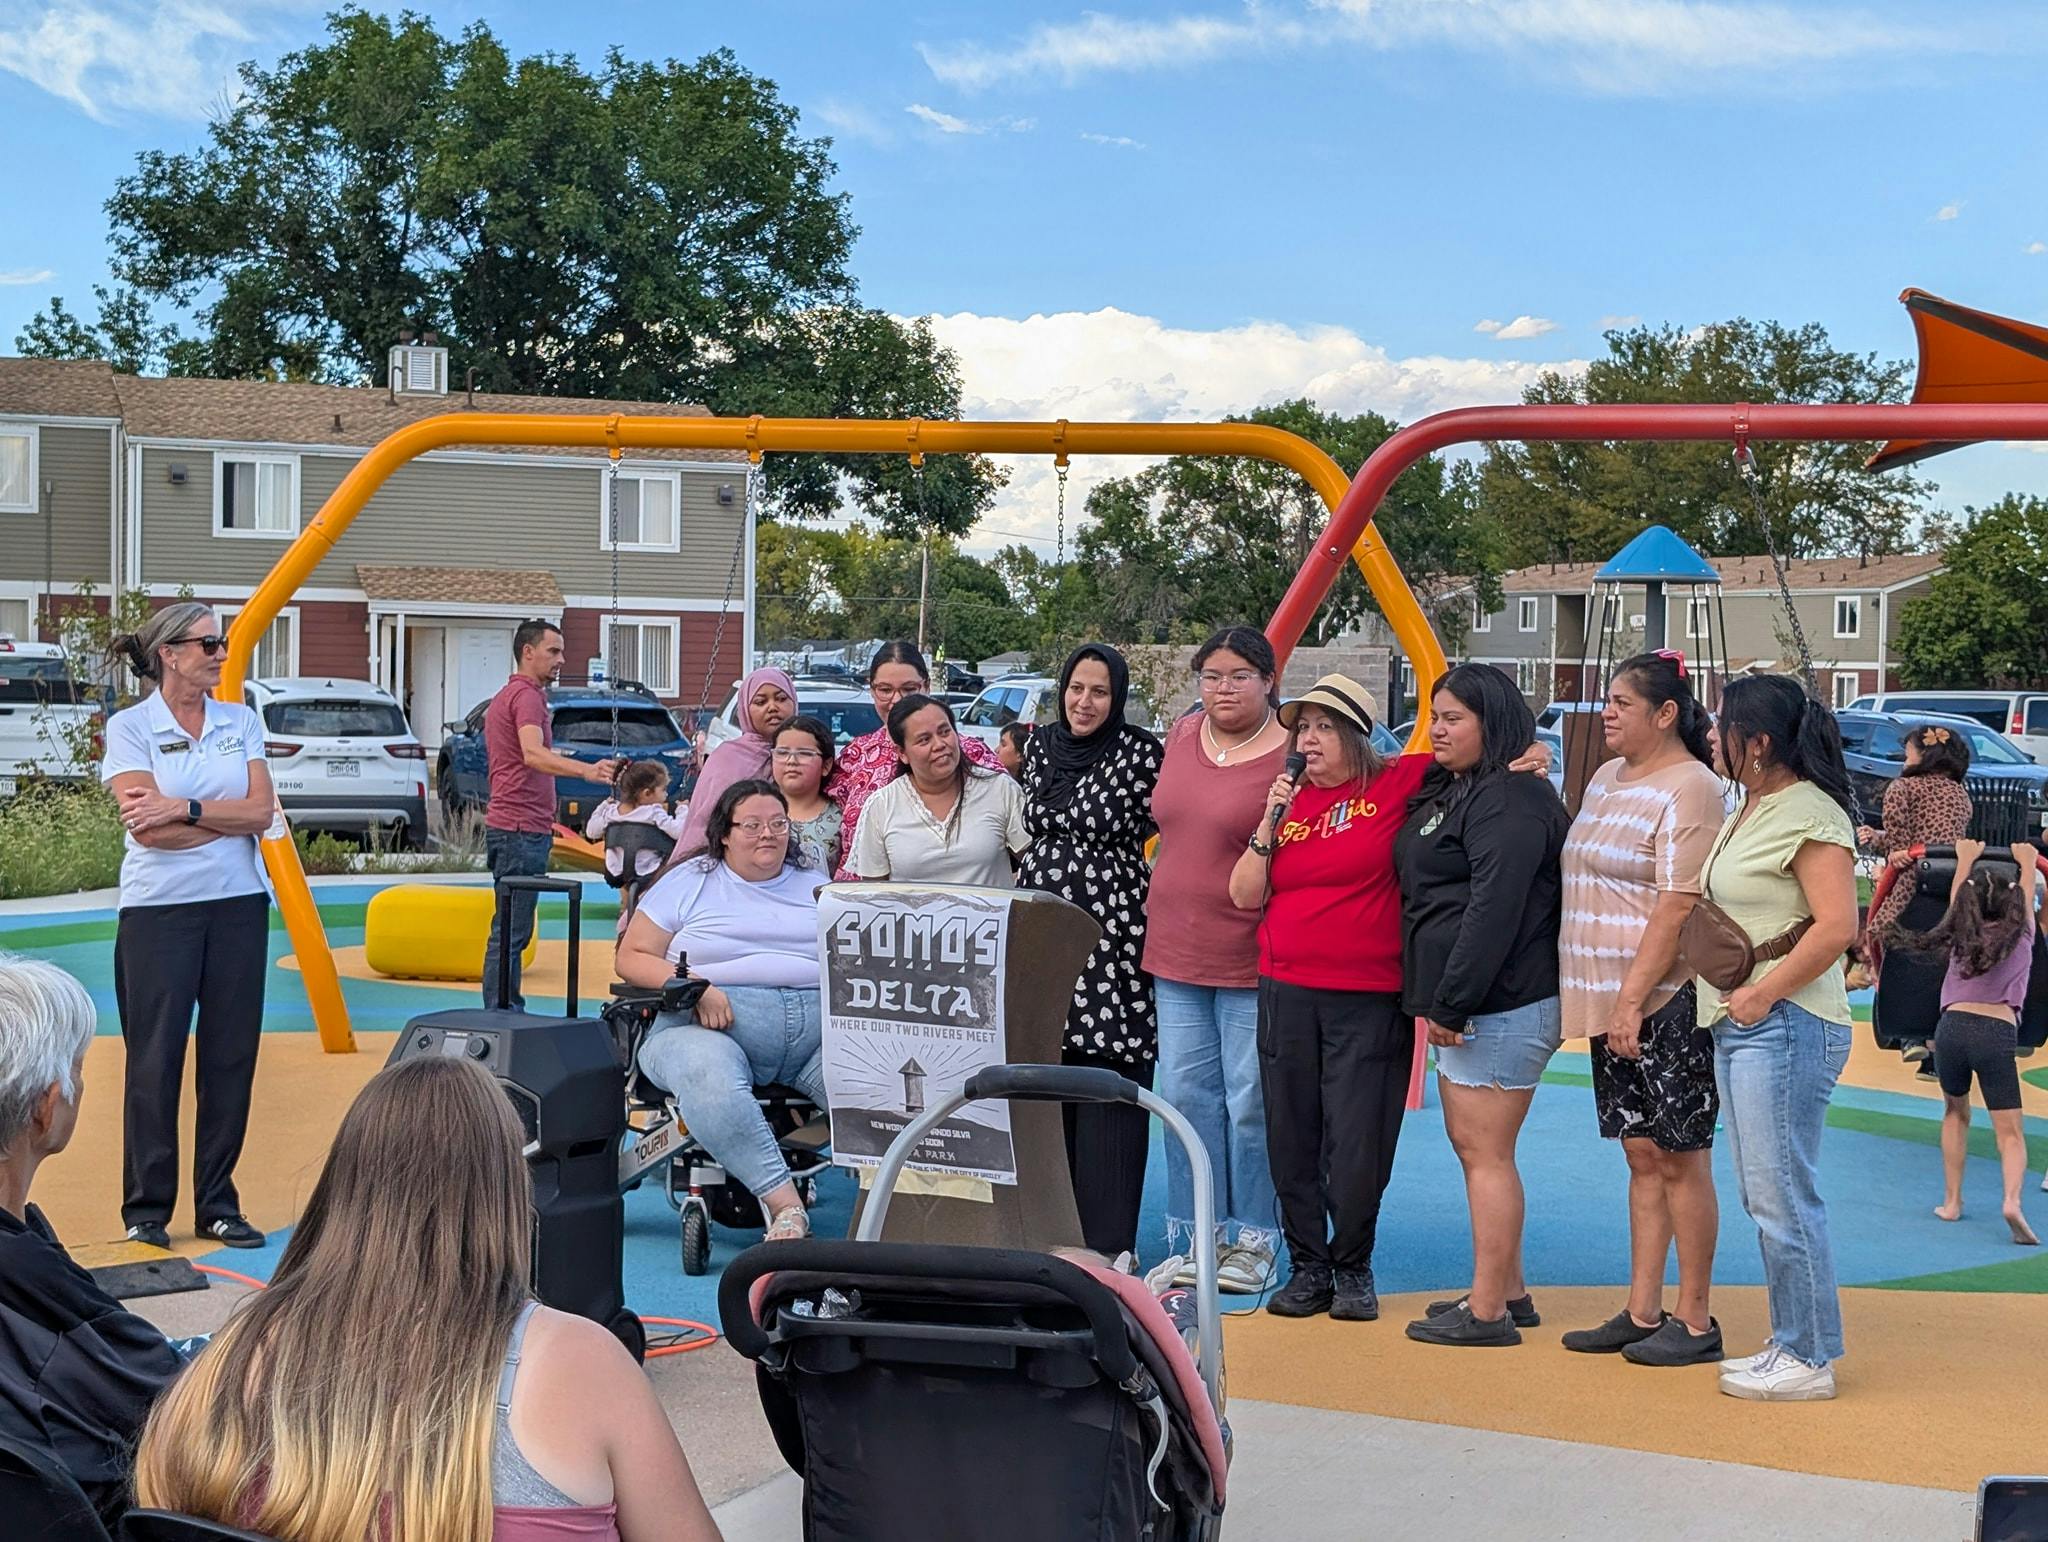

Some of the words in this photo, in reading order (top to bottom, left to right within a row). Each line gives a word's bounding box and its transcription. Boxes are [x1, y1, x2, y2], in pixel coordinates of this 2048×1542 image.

[833, 911, 999, 966] SOMOS
[846, 978, 980, 1018] DELTA
[830, 1018, 867, 1031] WHERE
[871, 1021, 891, 1033] OUR
[895, 1024, 919, 1037] TWO
[923, 1027, 962, 1040] RIVERS
[966, 1030, 996, 1043] MEET
[952, 1129, 971, 1139] SILVA
[925, 1149, 956, 1161] PARK
